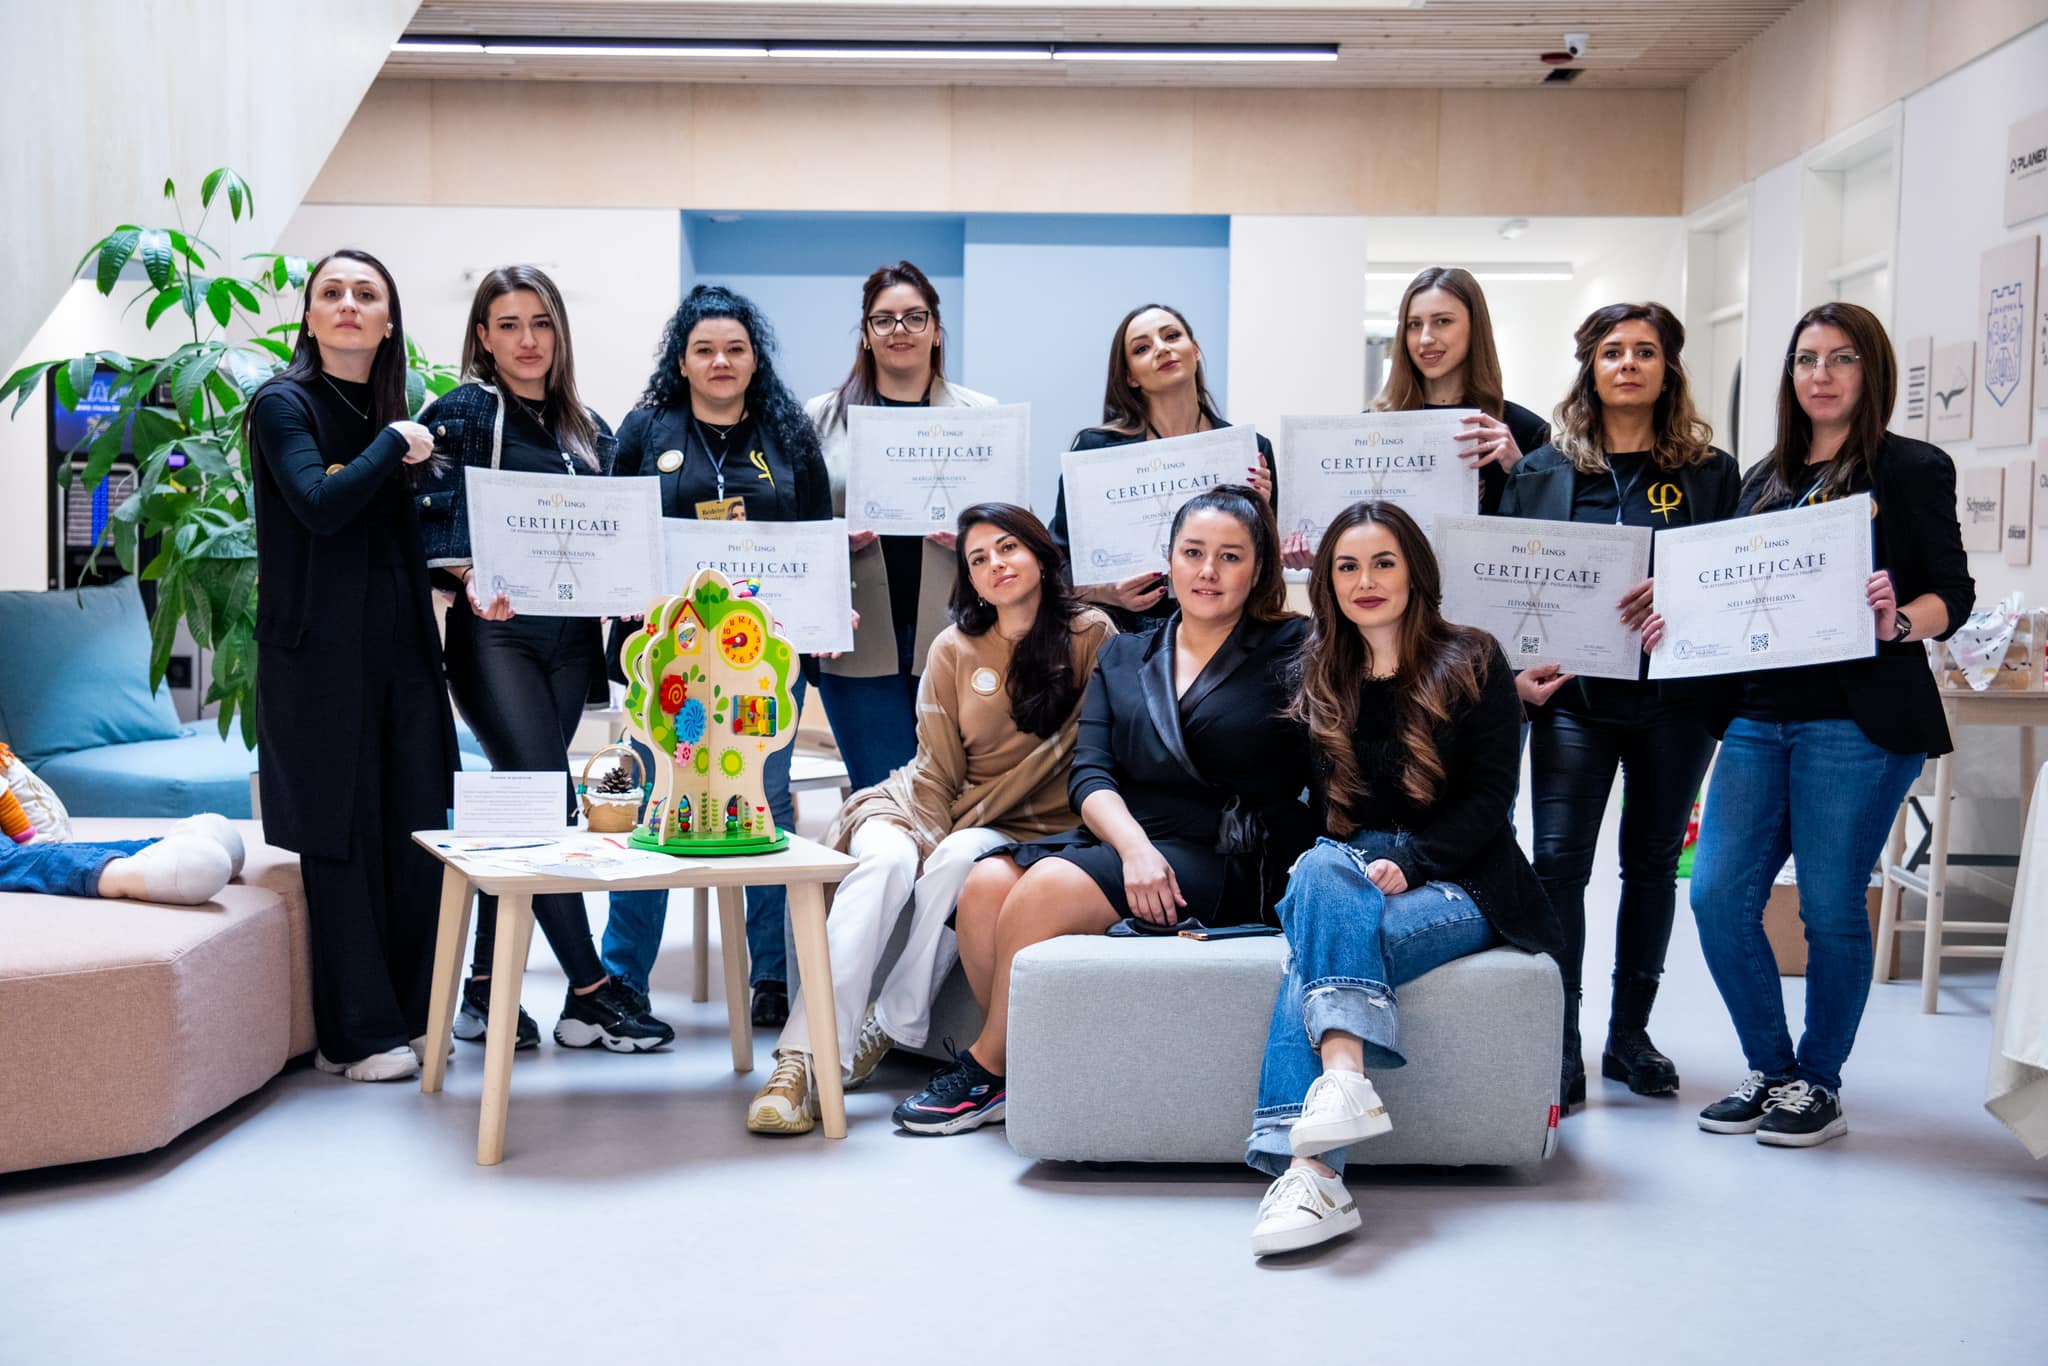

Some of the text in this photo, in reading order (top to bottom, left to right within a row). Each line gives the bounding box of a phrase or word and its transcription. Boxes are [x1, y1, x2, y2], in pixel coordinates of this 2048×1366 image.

[886, 446, 992, 458] CERTIFICATE
[1321, 454, 1437, 470] CERTIFICATE
[1106, 473, 1222, 500] CERTIFICATE
[506, 515, 621, 532] CERTIFICATE
[696, 560, 809, 573] CERTIFICATE
[1473, 562, 1601, 584] CERTIFICATE
[1698, 552, 1827, 583] CERTIFICATE
